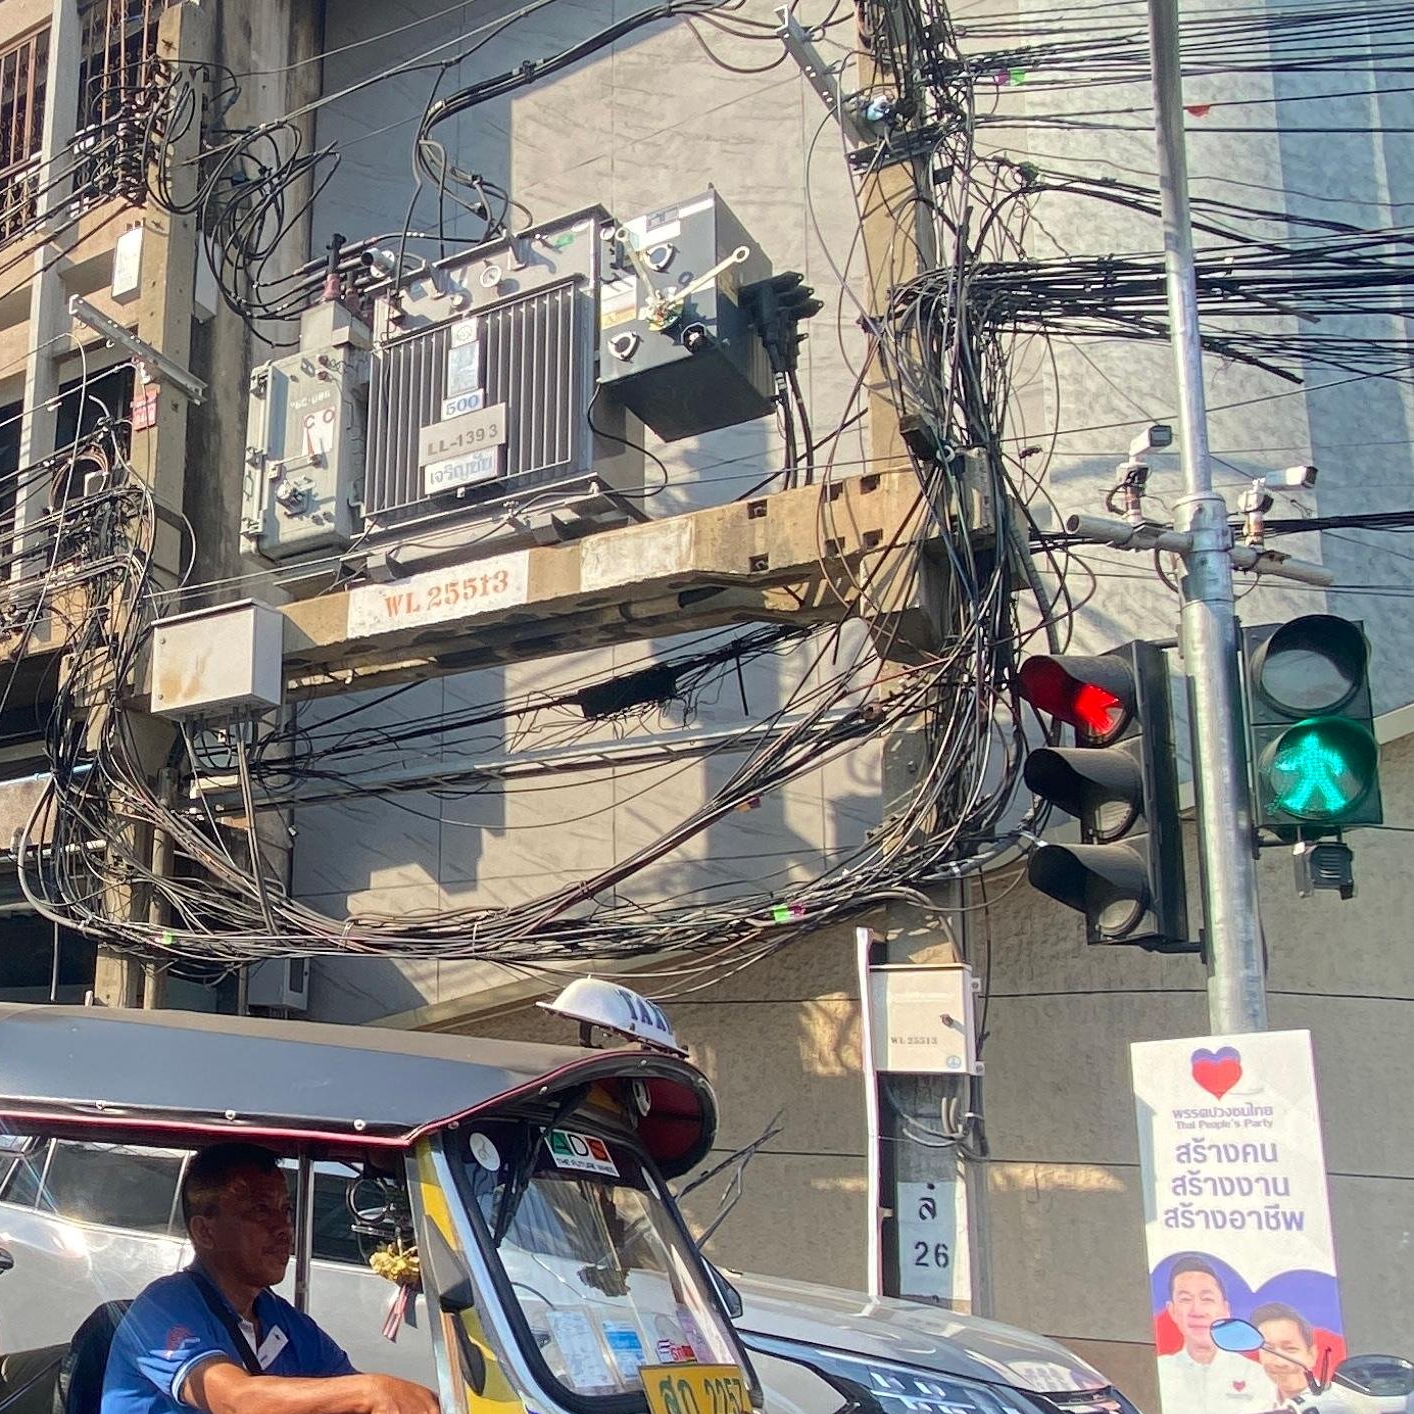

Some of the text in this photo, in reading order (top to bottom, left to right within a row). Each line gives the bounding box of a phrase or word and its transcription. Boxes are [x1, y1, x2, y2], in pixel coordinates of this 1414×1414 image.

[446, 394, 479, 417] 500
[384, 570, 509, 618] WL 25513
[1176, 1120, 1196, 1130] Thai
[1244, 1118, 1274, 1129] Party
[1176, 1137, 1278, 1164] สร้างคน
[1171, 1169, 1291, 1197] สร้างงาน
[1163, 1202, 1305, 1231] สร้างอาชีพ
[914, 1241, 950, 1268] 26
